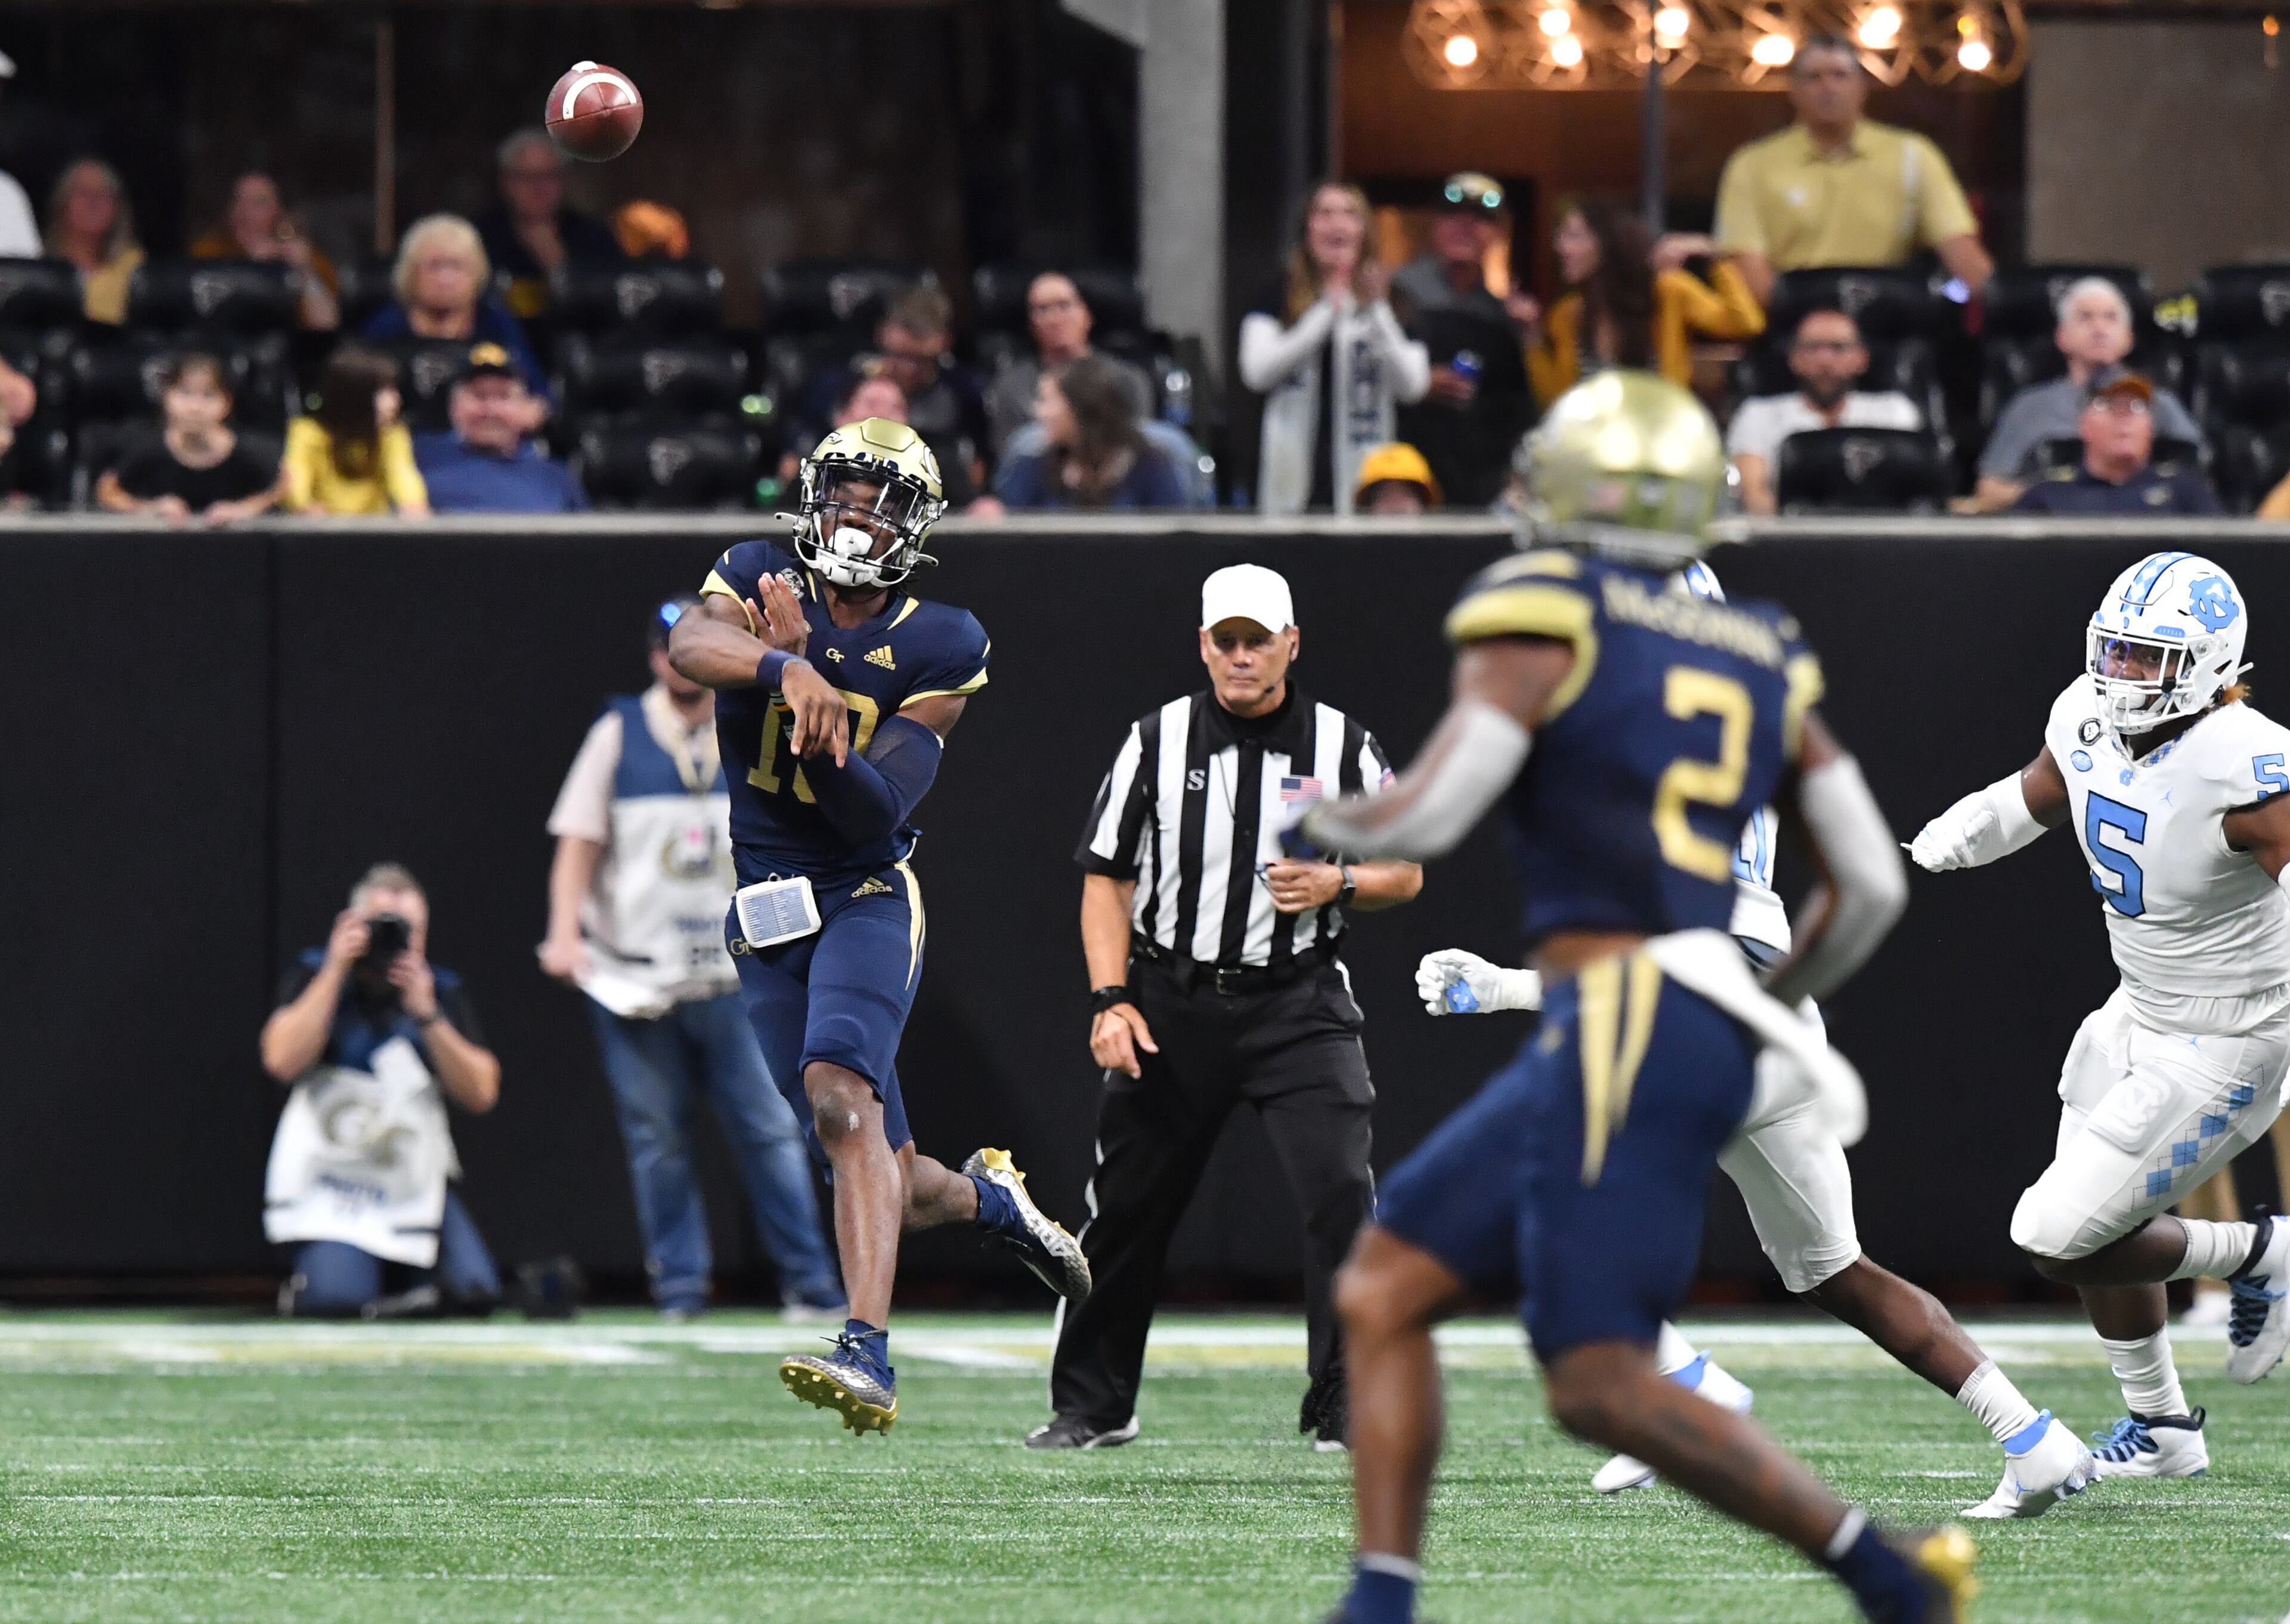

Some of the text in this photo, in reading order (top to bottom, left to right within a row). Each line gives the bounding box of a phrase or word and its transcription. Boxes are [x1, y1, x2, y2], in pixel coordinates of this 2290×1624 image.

[825, 647, 845, 663] GT
[864, 654, 896, 671] adidas
[1187, 768, 1205, 791] S
[1650, 664, 1755, 884] 2
[2252, 753, 2289, 801] 5
[2085, 789, 2147, 918] 5
[851, 885, 893, 898] adidas
